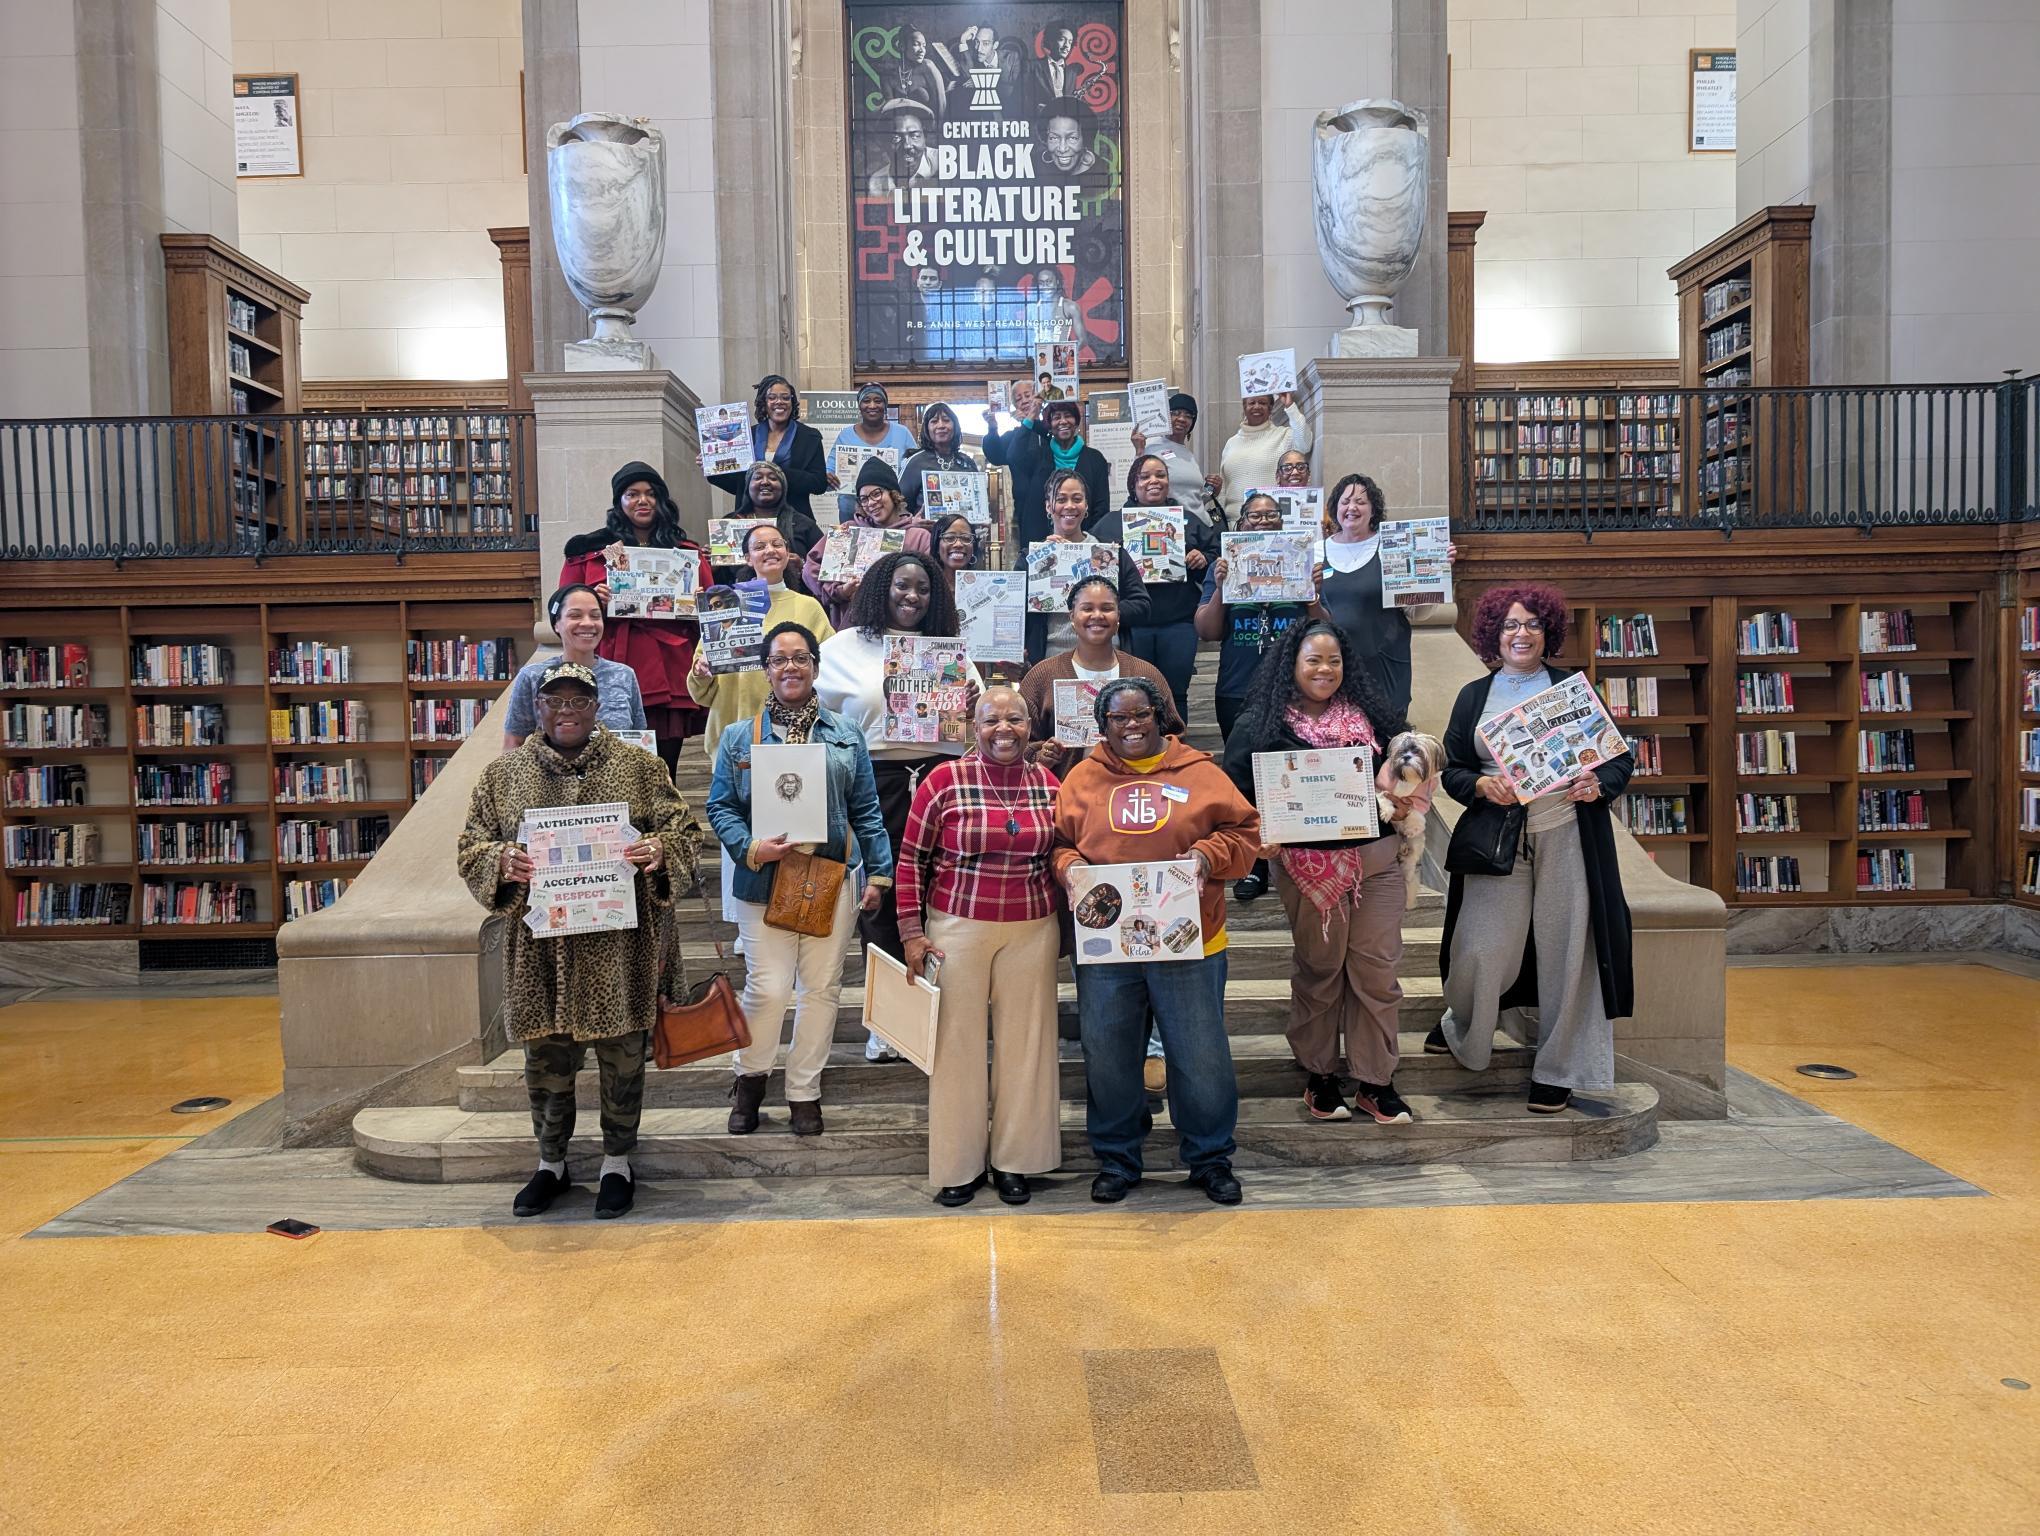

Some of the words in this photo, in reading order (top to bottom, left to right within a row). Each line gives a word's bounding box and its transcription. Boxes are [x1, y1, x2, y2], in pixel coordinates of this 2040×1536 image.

[943, 121, 1000, 138] CENTER
[1002, 120, 1030, 138] FOR
[938, 144, 1035, 180] BLACK
[894, 186, 1081, 224] LITERATURE
[903, 230, 928, 266] &
[934, 228, 1075, 266] CULTURE
[816, 400, 846, 409] LOOK
[1234, 618, 1296, 630] AFSM
[710, 637, 756, 650] FOCUS
[931, 642, 962, 650] COMMUNITY
[890, 679, 934, 692] MOTHER
[917, 692, 962, 701] BLACK
[934, 701, 960, 711] JOY
[1548, 706, 1578, 728] GLOW
[1578, 708, 1591, 717] UP
[944, 724, 959, 733] LOVE
[1545, 732, 1564, 748] GIRLS
[1550, 740, 1564, 753] TRIP
[1300, 775, 1335, 783] THRIVE
[1521, 778, 1535, 790] OUT
[1532, 776, 1554, 794] ABOUT
[1334, 792, 1367, 802] GLOWING
[536, 814, 620, 830] AUTHENTICITY
[1304, 816, 1338, 825] SMILE
[543, 874, 618, 889] ACCEPTANCE
[1168, 868, 1192, 886] HEALTHY
[554, 889, 606, 901] RESPECT
